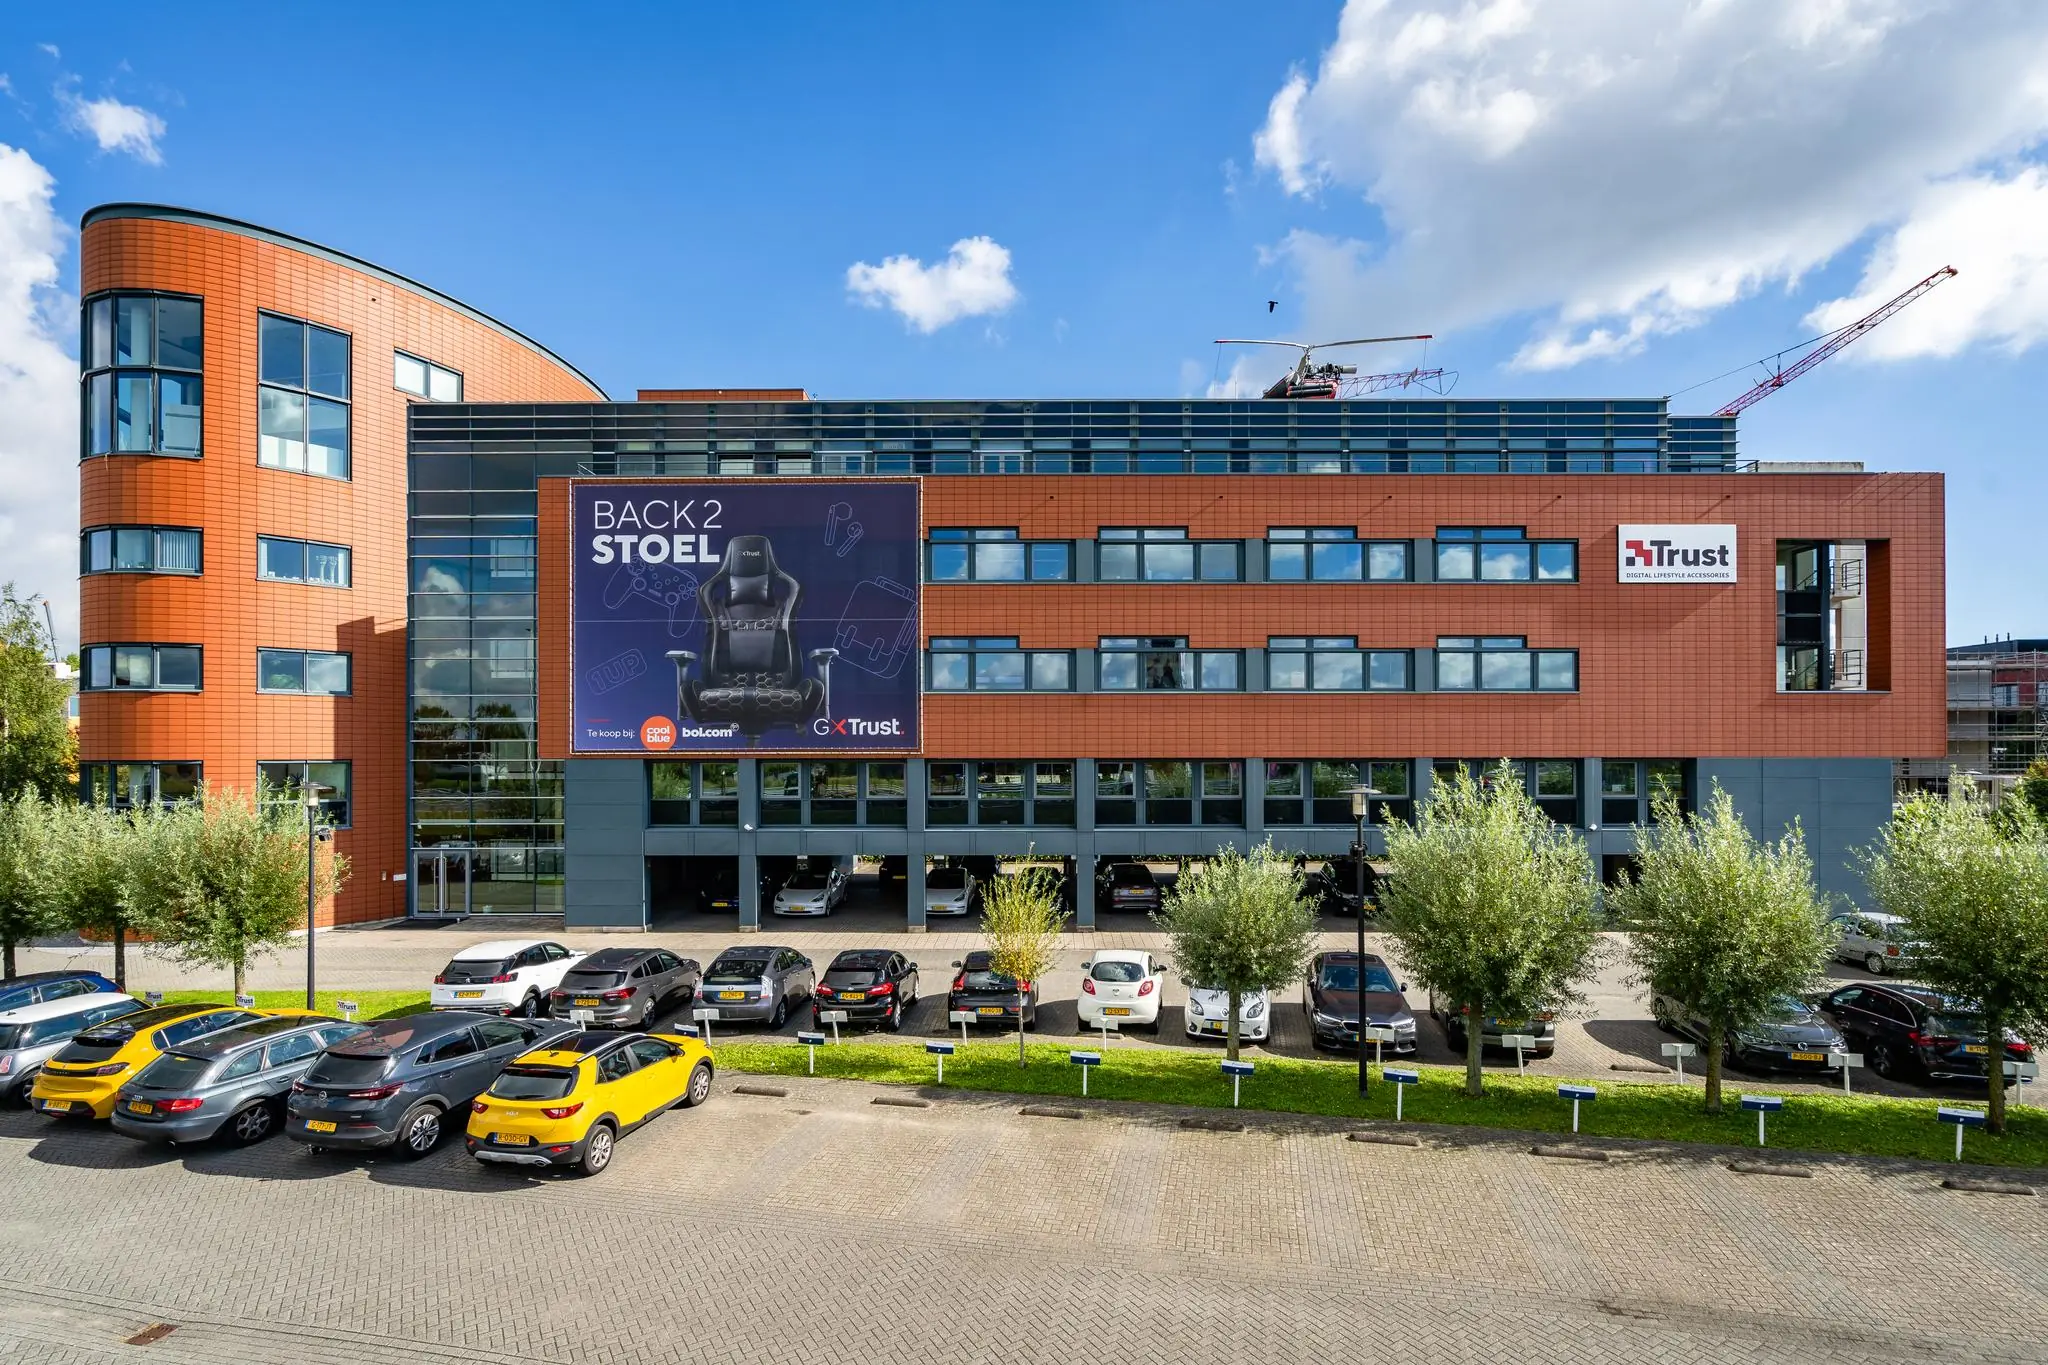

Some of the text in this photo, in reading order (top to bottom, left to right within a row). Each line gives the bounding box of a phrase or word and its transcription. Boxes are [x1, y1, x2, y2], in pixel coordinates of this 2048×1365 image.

[594, 500, 722, 529] BACK 2
[591, 534, 720, 564] STOEL
[1650, 540, 1729, 567] Trust
[591, 654, 640, 691] 1UP
[587, 729, 636, 739] Te koop bij:
[646, 725, 670, 735] cool
[646, 734, 670, 743] blue
[682, 727, 733, 738] bol.com
